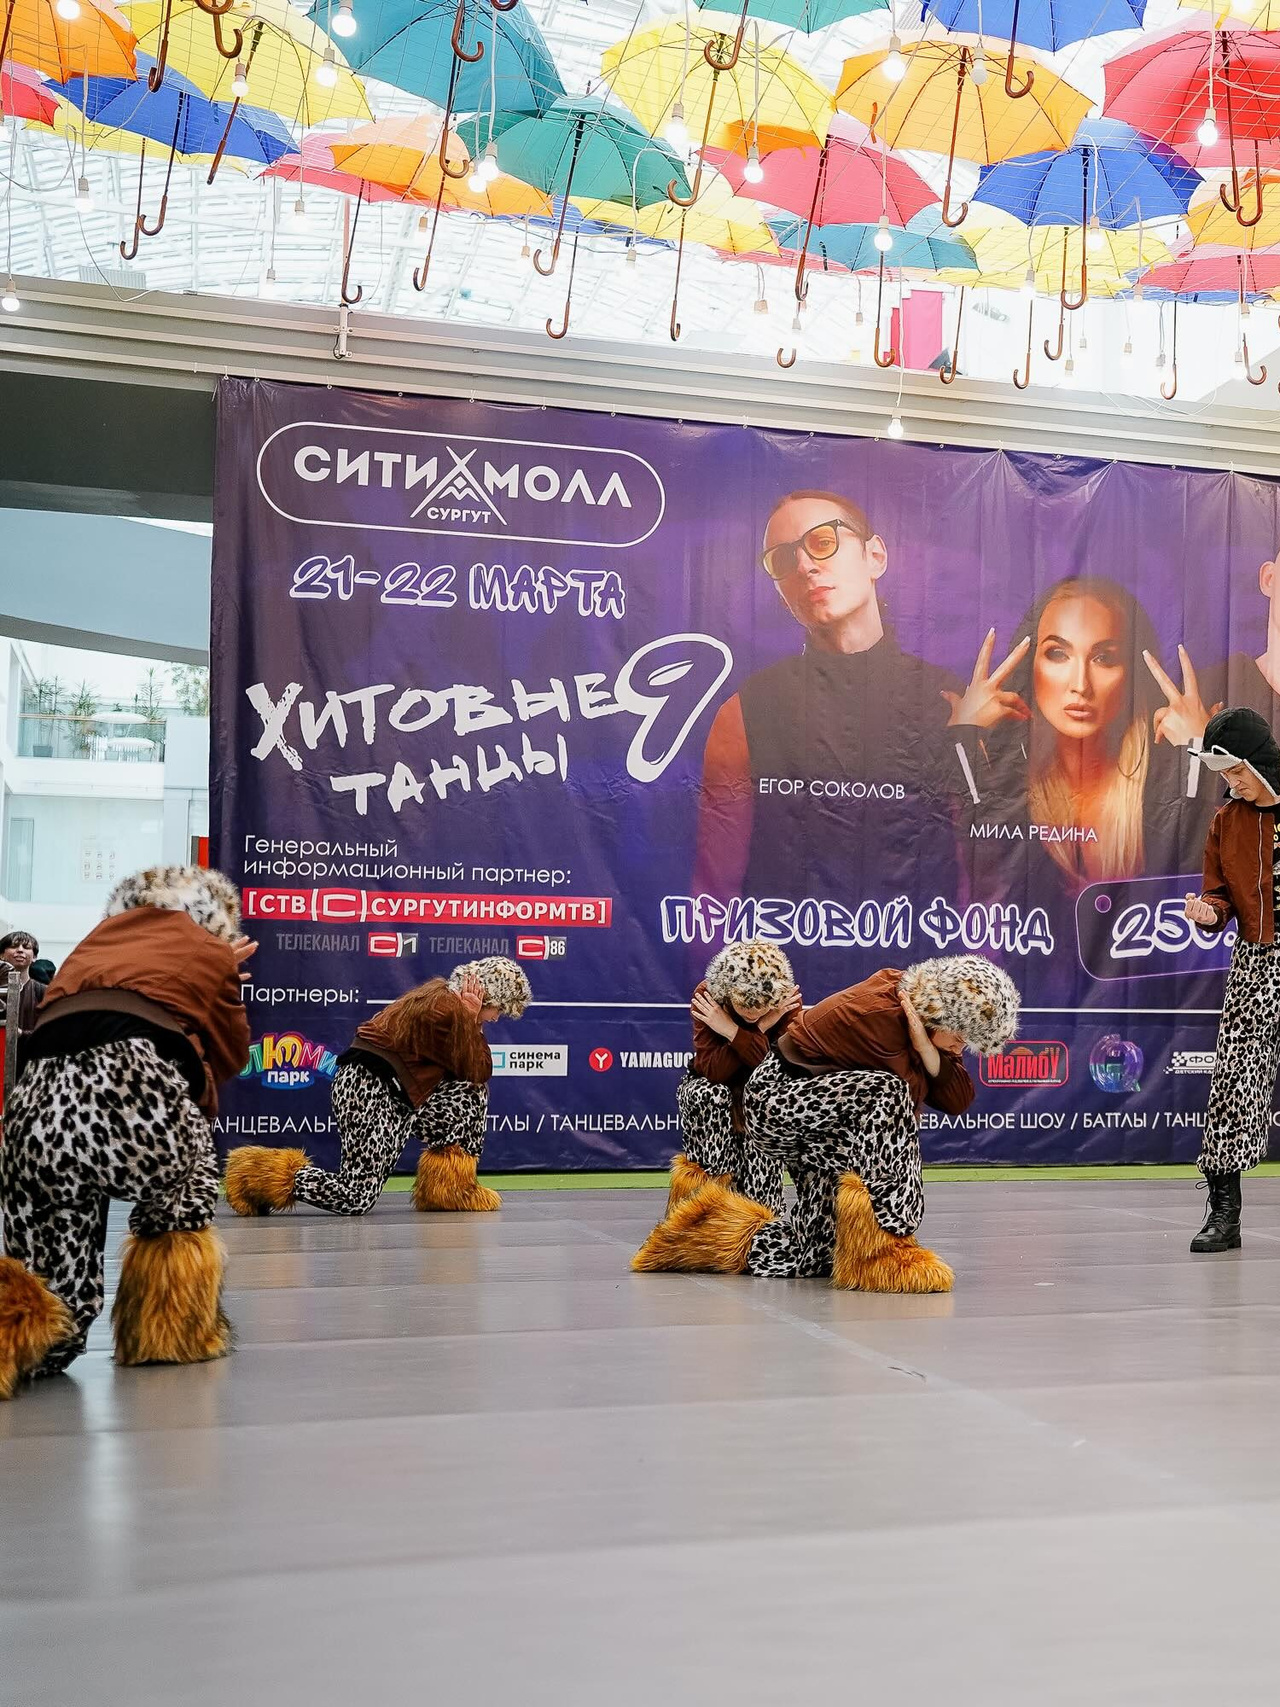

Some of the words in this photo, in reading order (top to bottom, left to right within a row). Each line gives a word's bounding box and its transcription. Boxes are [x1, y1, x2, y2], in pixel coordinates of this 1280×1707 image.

[293, 445, 436, 490] СИТИ
[484, 461, 632, 508] МОЛЛ
[427, 506, 492, 524] СУРГУТ
[290, 555, 457, 607] 21-22
[469, 562, 627, 618] МАРТА
[246, 672, 620, 770] ХИТОВЫЕ
[330, 733, 568, 815] ТАНЦЫ
[759, 778, 804, 796] ЕГОР
[810, 780, 905, 800] СОКОЛОВ
[970, 823, 1023, 841] МИЛА
[1029, 825, 1098, 843] РЕДИНА
[245, 835, 398, 858] Генеральный
[244, 857, 464, 881] информационный
[472, 865, 571, 887] партнер:
[660, 894, 913, 948] ПРИЗОВОЙ
[919, 896, 1055, 956] ФОНД
[276, 933, 360, 952] ТЕЛЕКАНАЛ
[429, 936, 509, 955] ТЕЛЕКАНАЛ
[241, 984, 359, 1006] Партнеры:
[509, 1051, 561, 1060] синема
[509, 1061, 544, 1072] парк
[620, 1051, 697, 1069] YAMAGUC
[267, 1070, 310, 1086] парк
[213, 1116, 338, 1135] АНЦЕВАЛЬН
[550, 1113, 684, 1132] ТАНЦЕВАЛЬН
[919, 1112, 1015, 1129] ЕВАЛЬНОЕ
[1020, 1112, 1065, 1129] ШОУ
[1083, 1112, 1147, 1128] БАТТЛЫ
